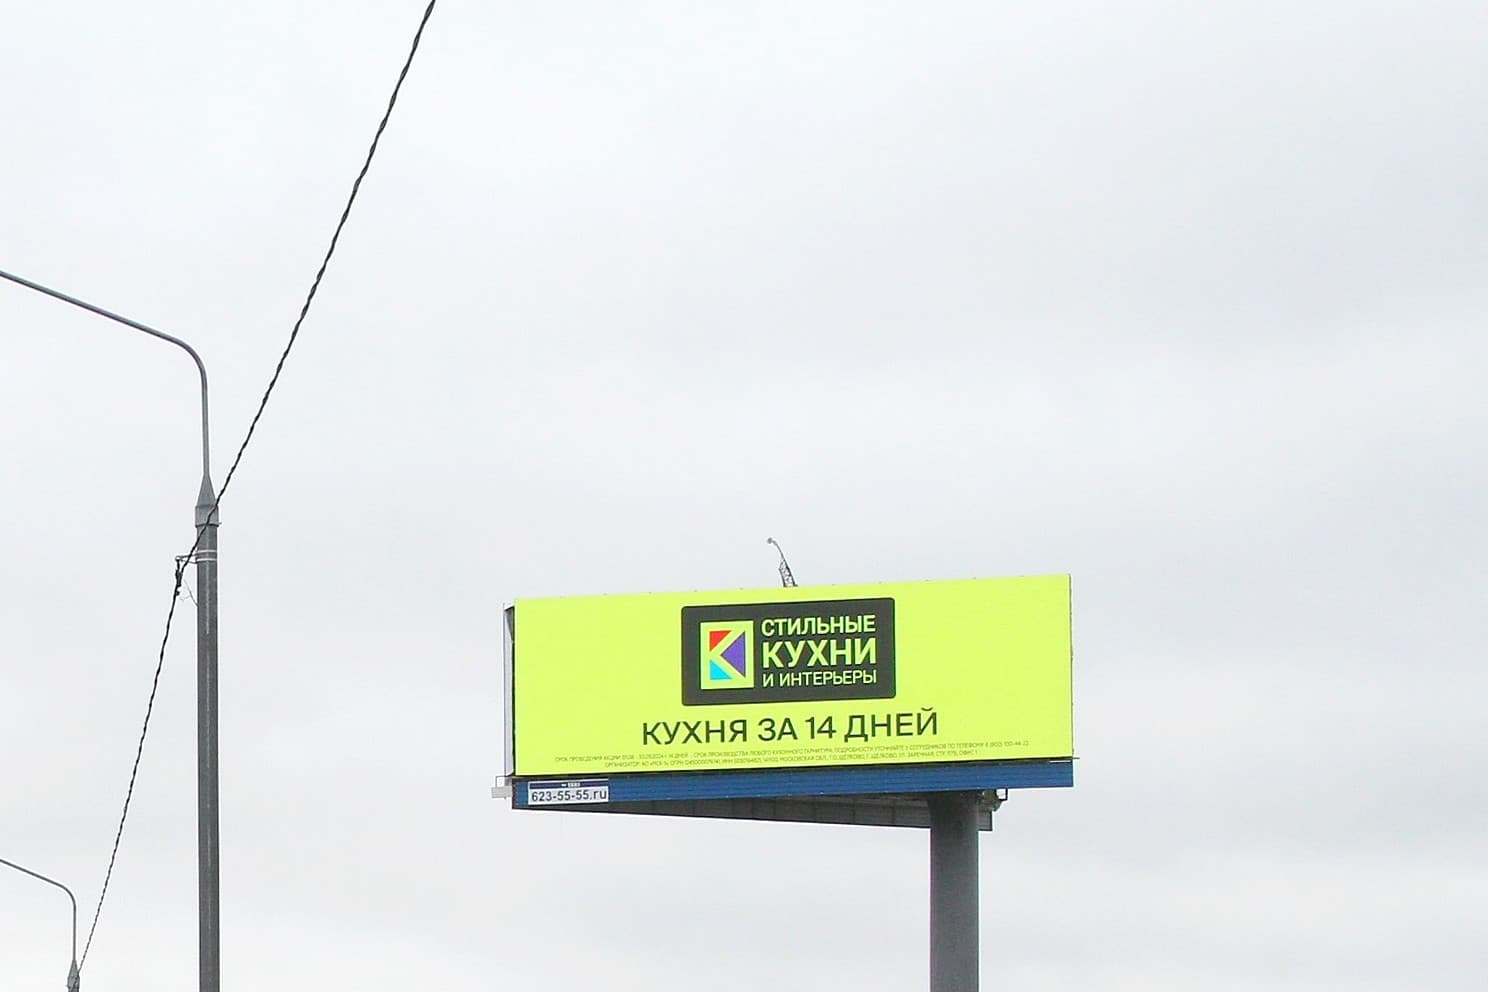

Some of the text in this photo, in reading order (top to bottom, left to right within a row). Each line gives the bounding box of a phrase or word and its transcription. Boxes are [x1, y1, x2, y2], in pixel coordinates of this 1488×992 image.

[761, 614, 876, 636] СТИЛЬНЫЕ
[762, 638, 877, 668] КУХНИ
[762, 669, 877, 688] И ИНТЕРЬЕРЫ
[642, 707, 938, 745] КУХНЯ ЗА 14 ДНЕЙ
[531, 789, 608, 802] 623-55-55.ru
